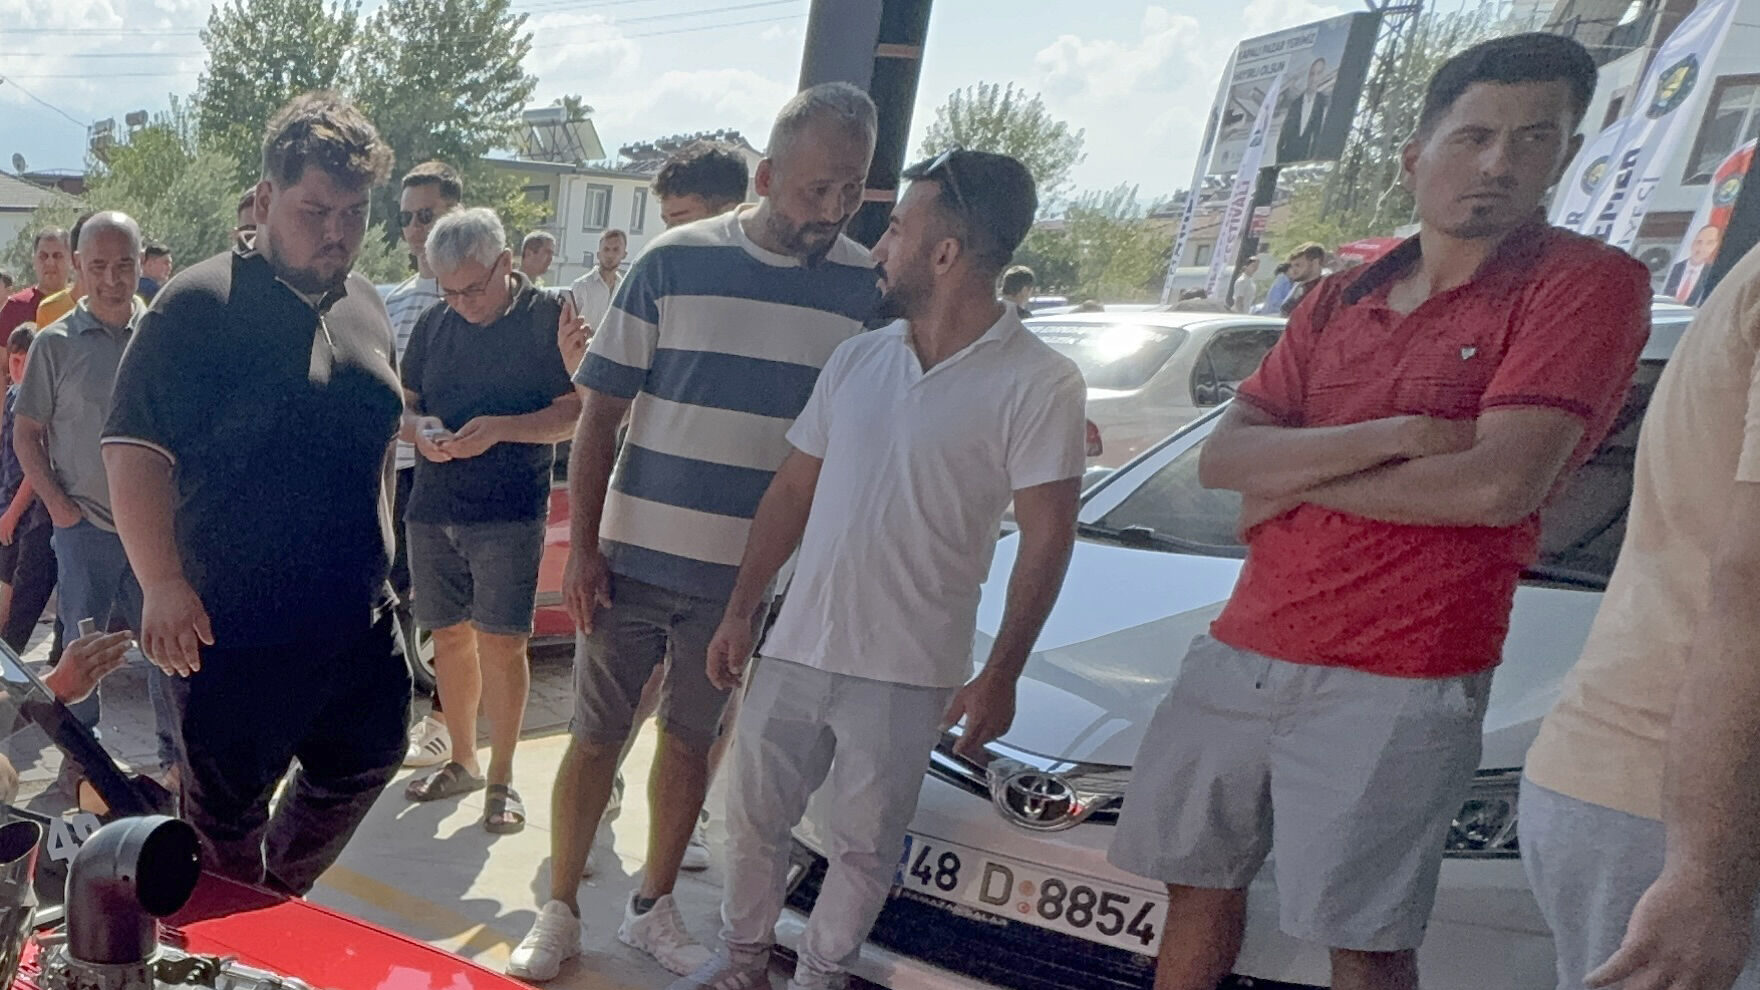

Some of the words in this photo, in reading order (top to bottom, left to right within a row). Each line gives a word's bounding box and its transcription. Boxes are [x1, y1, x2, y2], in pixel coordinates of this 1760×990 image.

[909, 845, 961, 892] 48
[978, 861, 1014, 906] D
[1036, 878, 1155, 946] 8854
